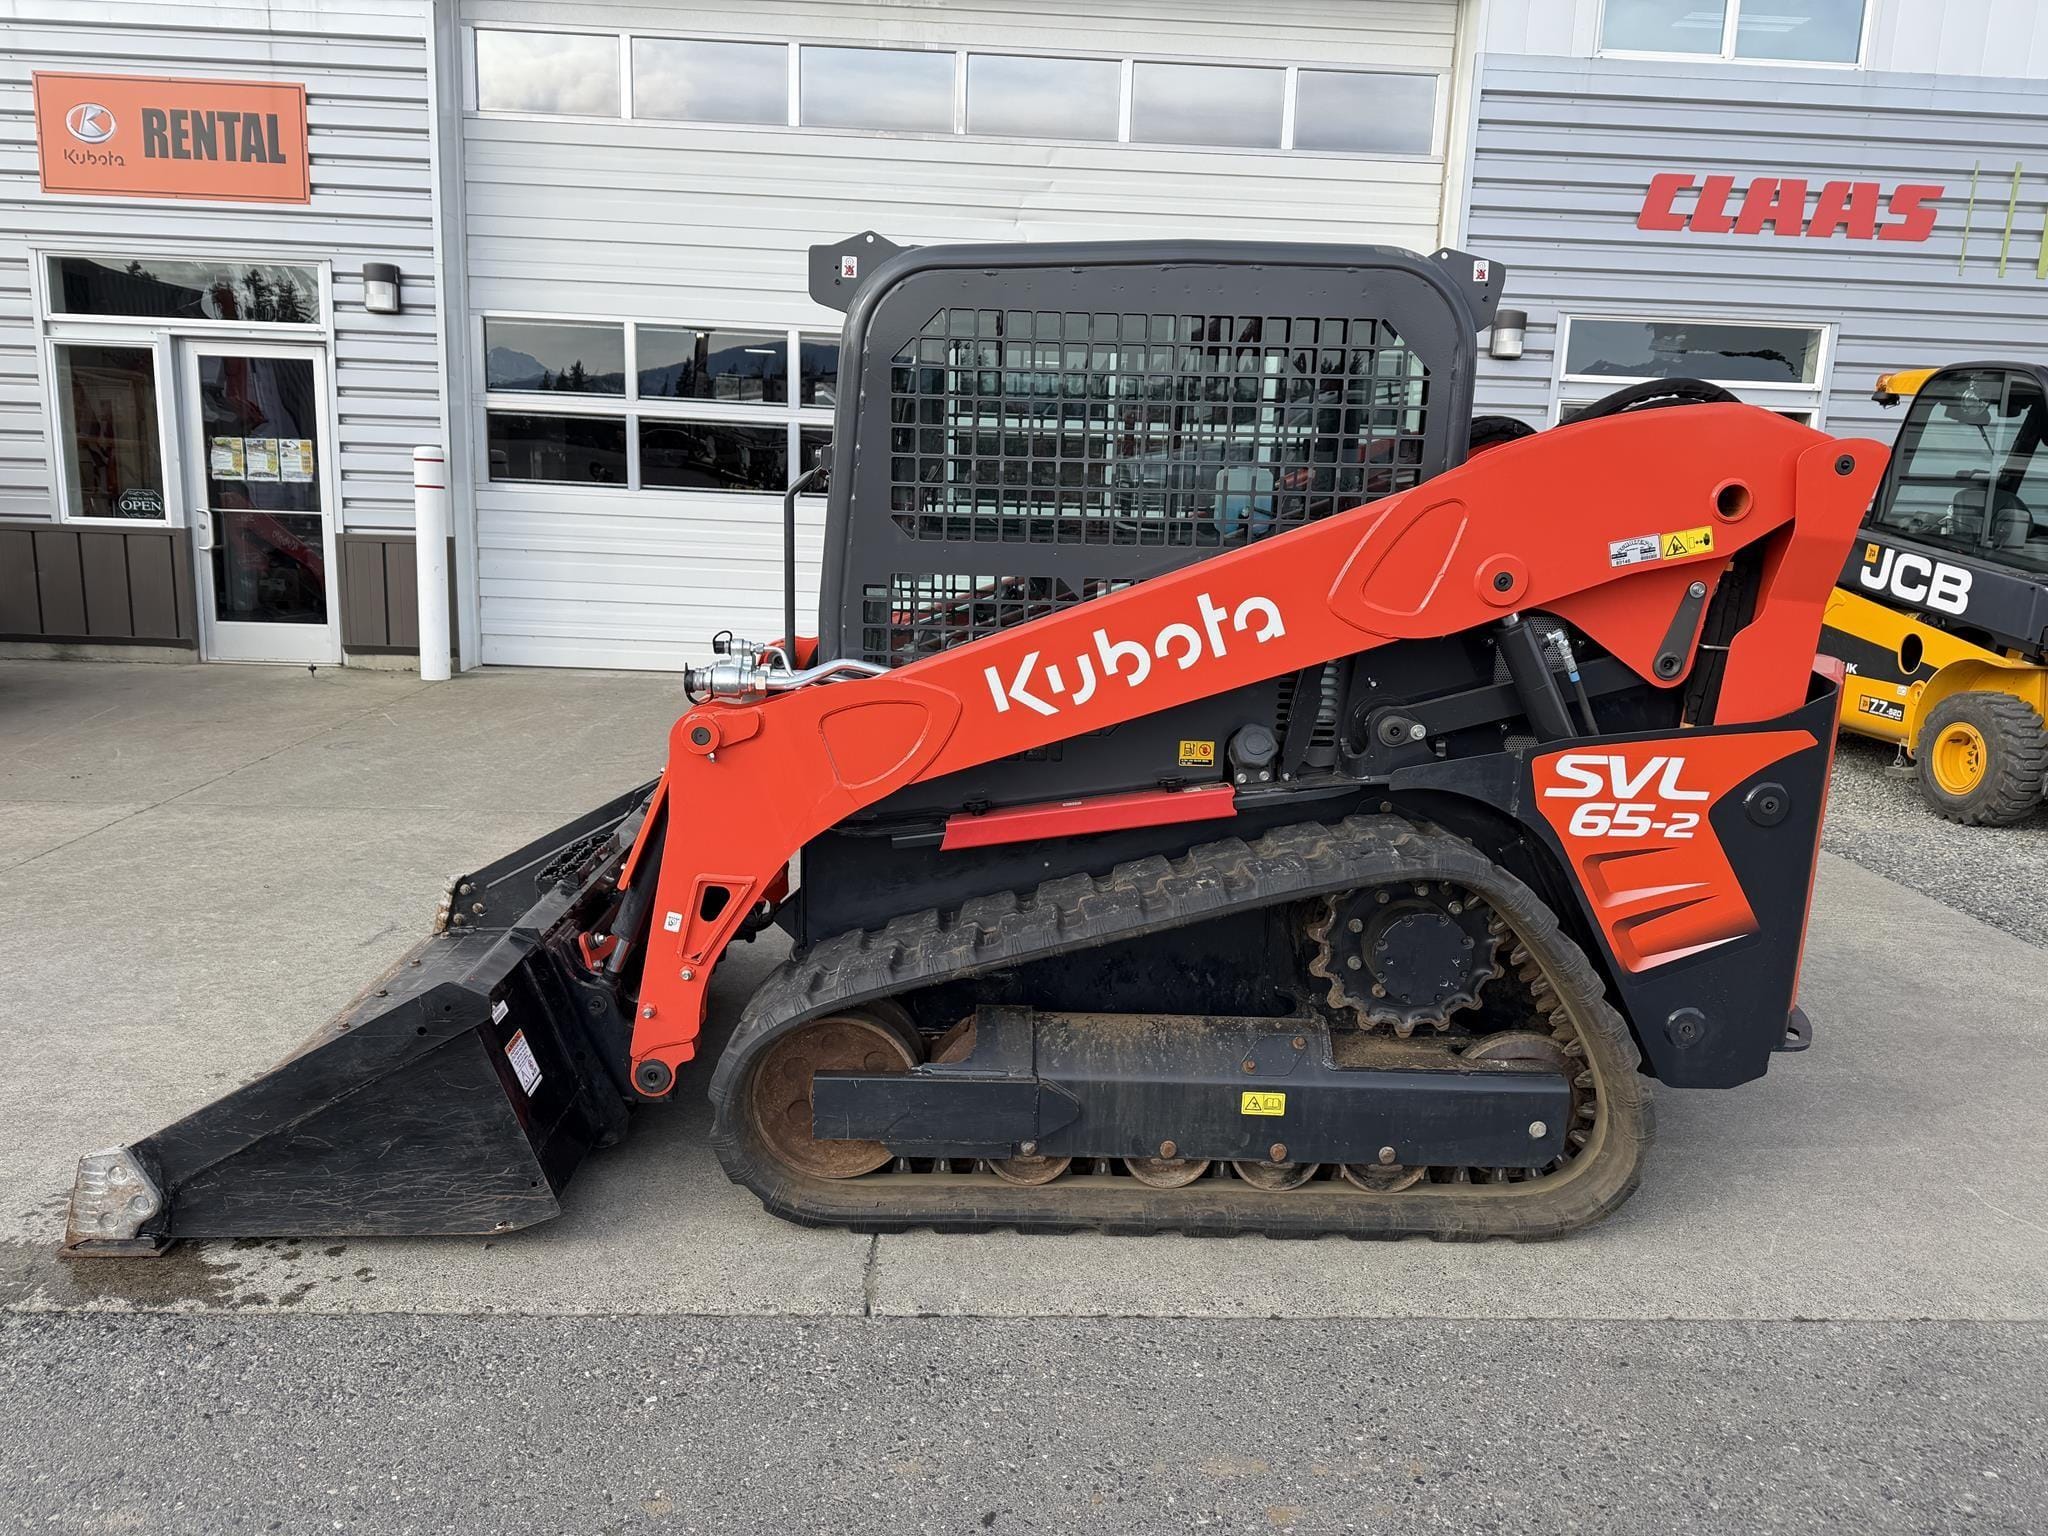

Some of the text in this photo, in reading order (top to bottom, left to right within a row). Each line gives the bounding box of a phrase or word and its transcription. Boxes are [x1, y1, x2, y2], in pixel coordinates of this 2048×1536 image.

[63, 148, 126, 167] Kubota
[141, 108, 287, 165] RENTAL
[1636, 172, 1946, 242] CLAAS
[121, 500, 161, 510] OPEN
[1860, 547, 1973, 615] JCB
[984, 592, 1286, 717] Kubota
[1544, 754, 1710, 801] SVL
[1568, 802, 1700, 839] 65-2
